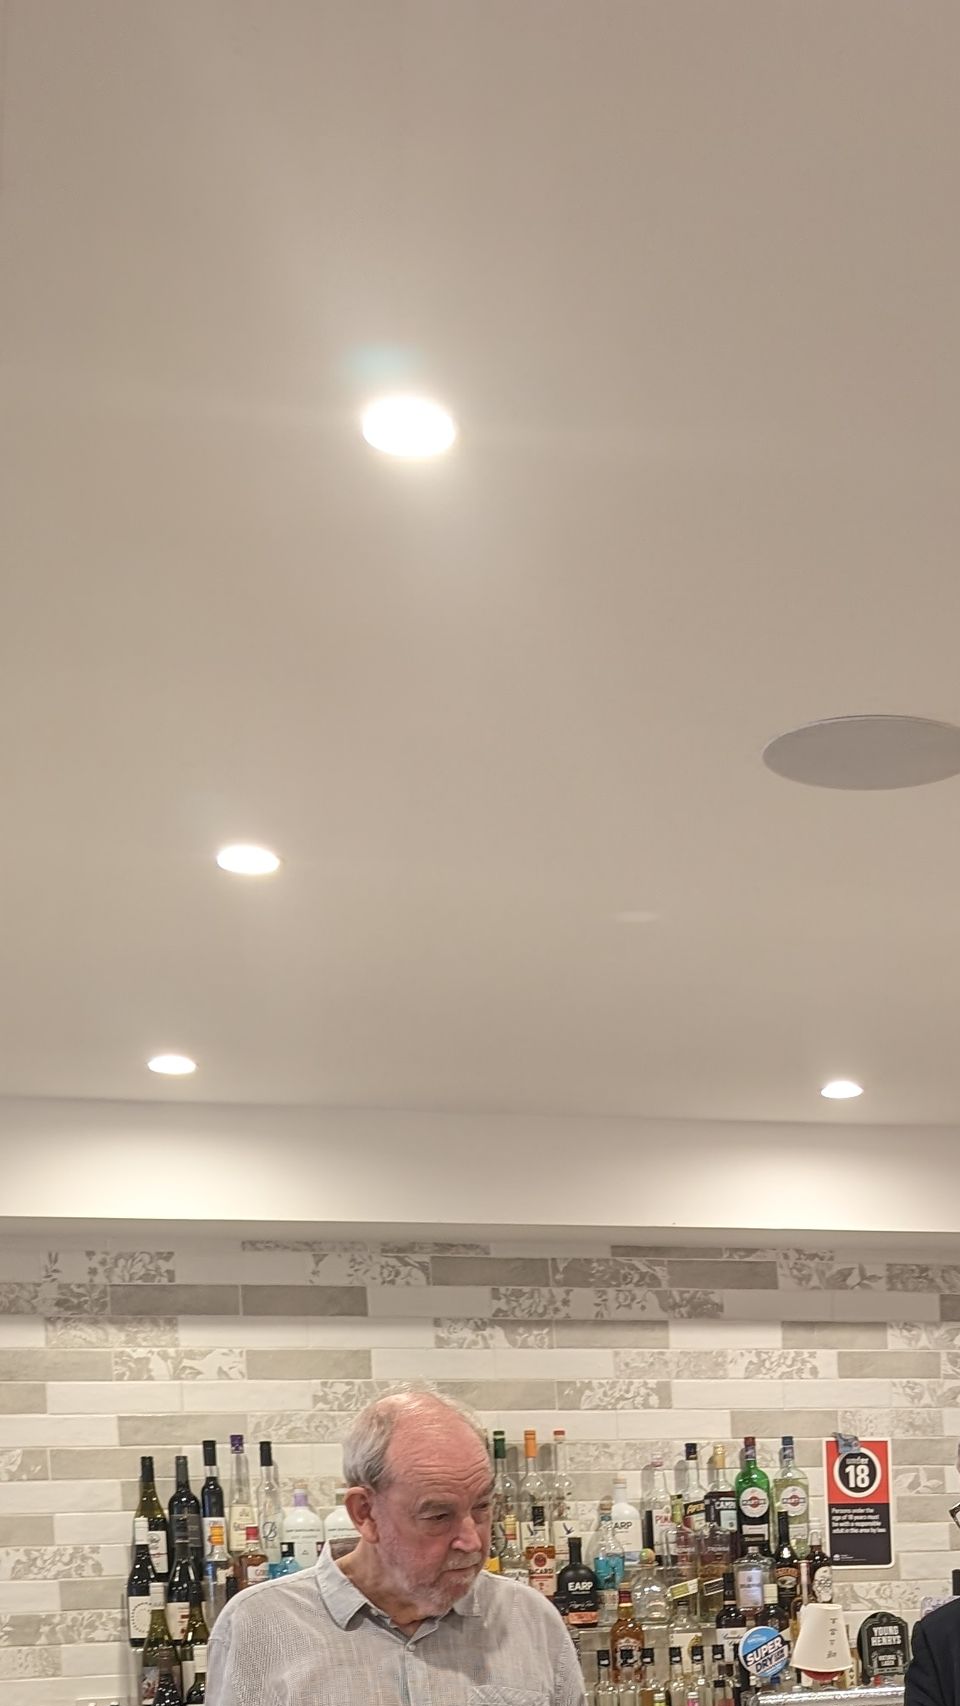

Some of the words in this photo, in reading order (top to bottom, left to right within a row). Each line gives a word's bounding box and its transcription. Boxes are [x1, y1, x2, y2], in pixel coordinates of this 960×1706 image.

[845, 1465, 870, 1488] 18
[613, 1521, 633, 1530] ARP
[567, 1581, 594, 1592] EARP
[746, 1636, 783, 1666] SUPER
[755, 1653, 774, 1673] DRY
